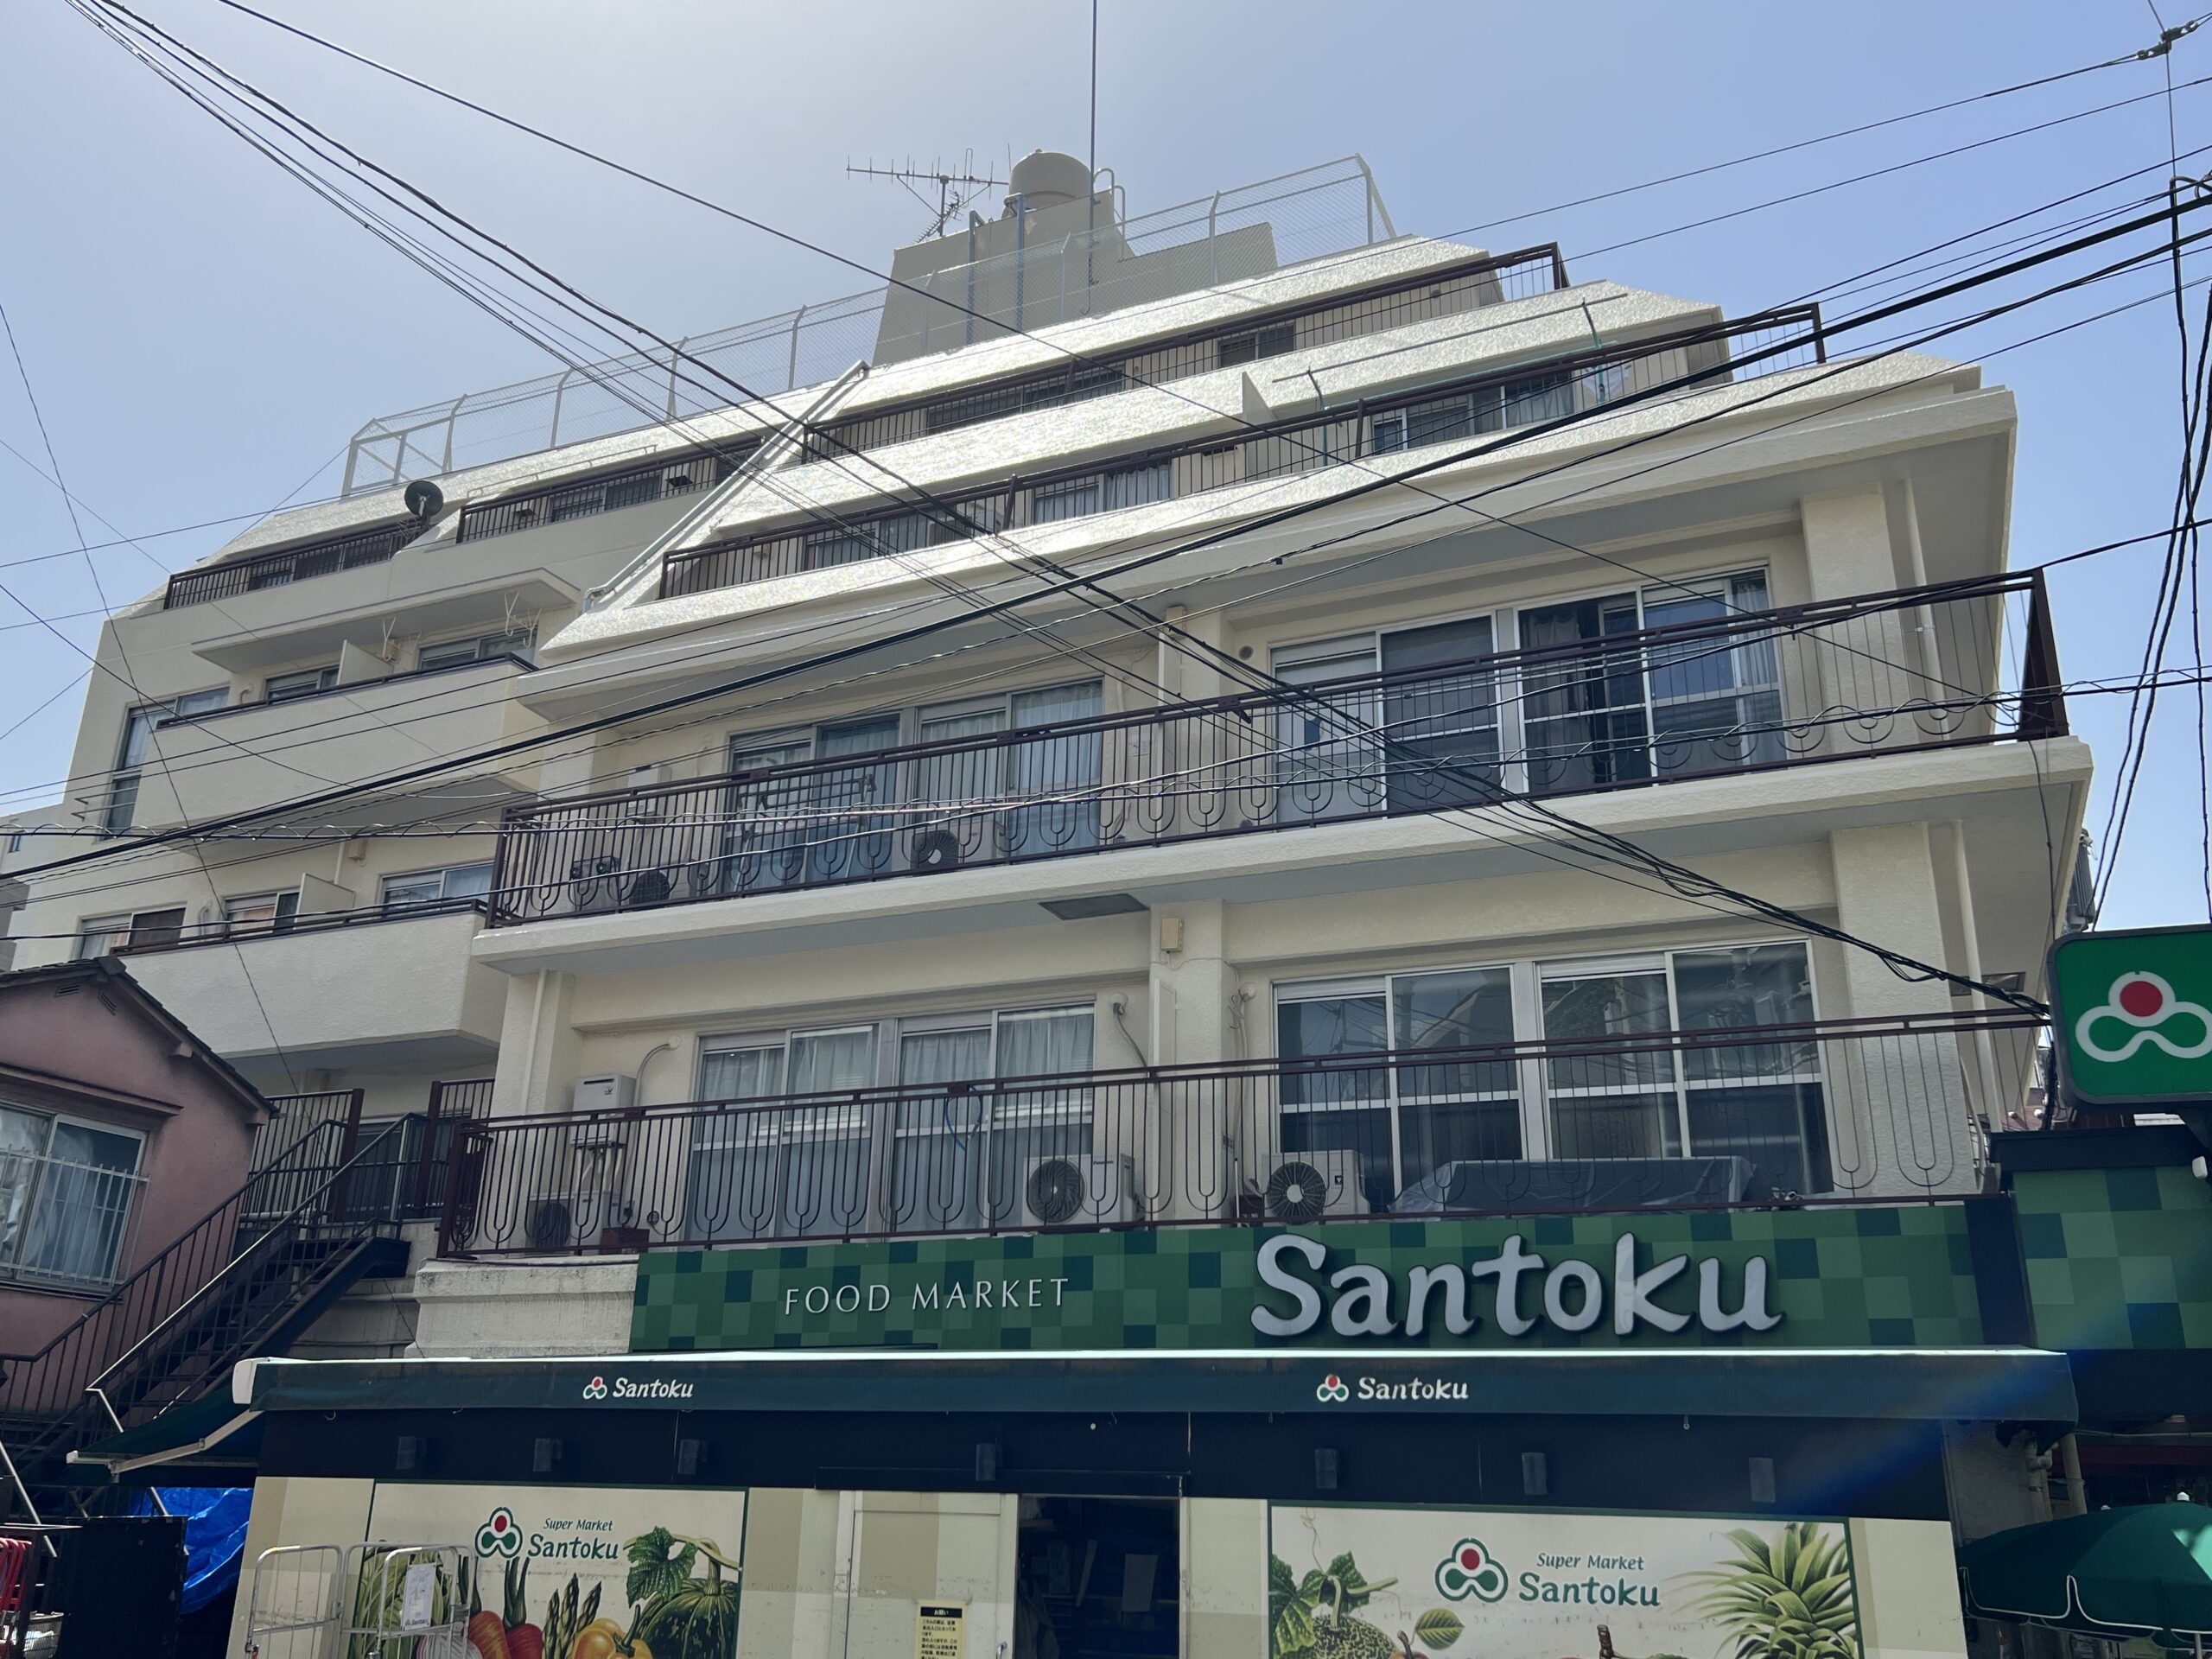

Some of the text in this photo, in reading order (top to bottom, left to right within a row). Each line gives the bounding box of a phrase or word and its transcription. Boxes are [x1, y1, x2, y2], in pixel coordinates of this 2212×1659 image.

[1250, 1231, 1784, 1337] Santoku
[785, 1278, 1069, 1316] FOOD MARKET
[612, 1376, 694, 1398] Santoku
[1357, 1376, 1469, 1400] Santoku
[543, 1518, 613, 1531] Super Market
[527, 1533, 619, 1560] Santoku
[1536, 1552, 1645, 1570] Super Market
[1518, 1571, 1661, 1606] Santoku
